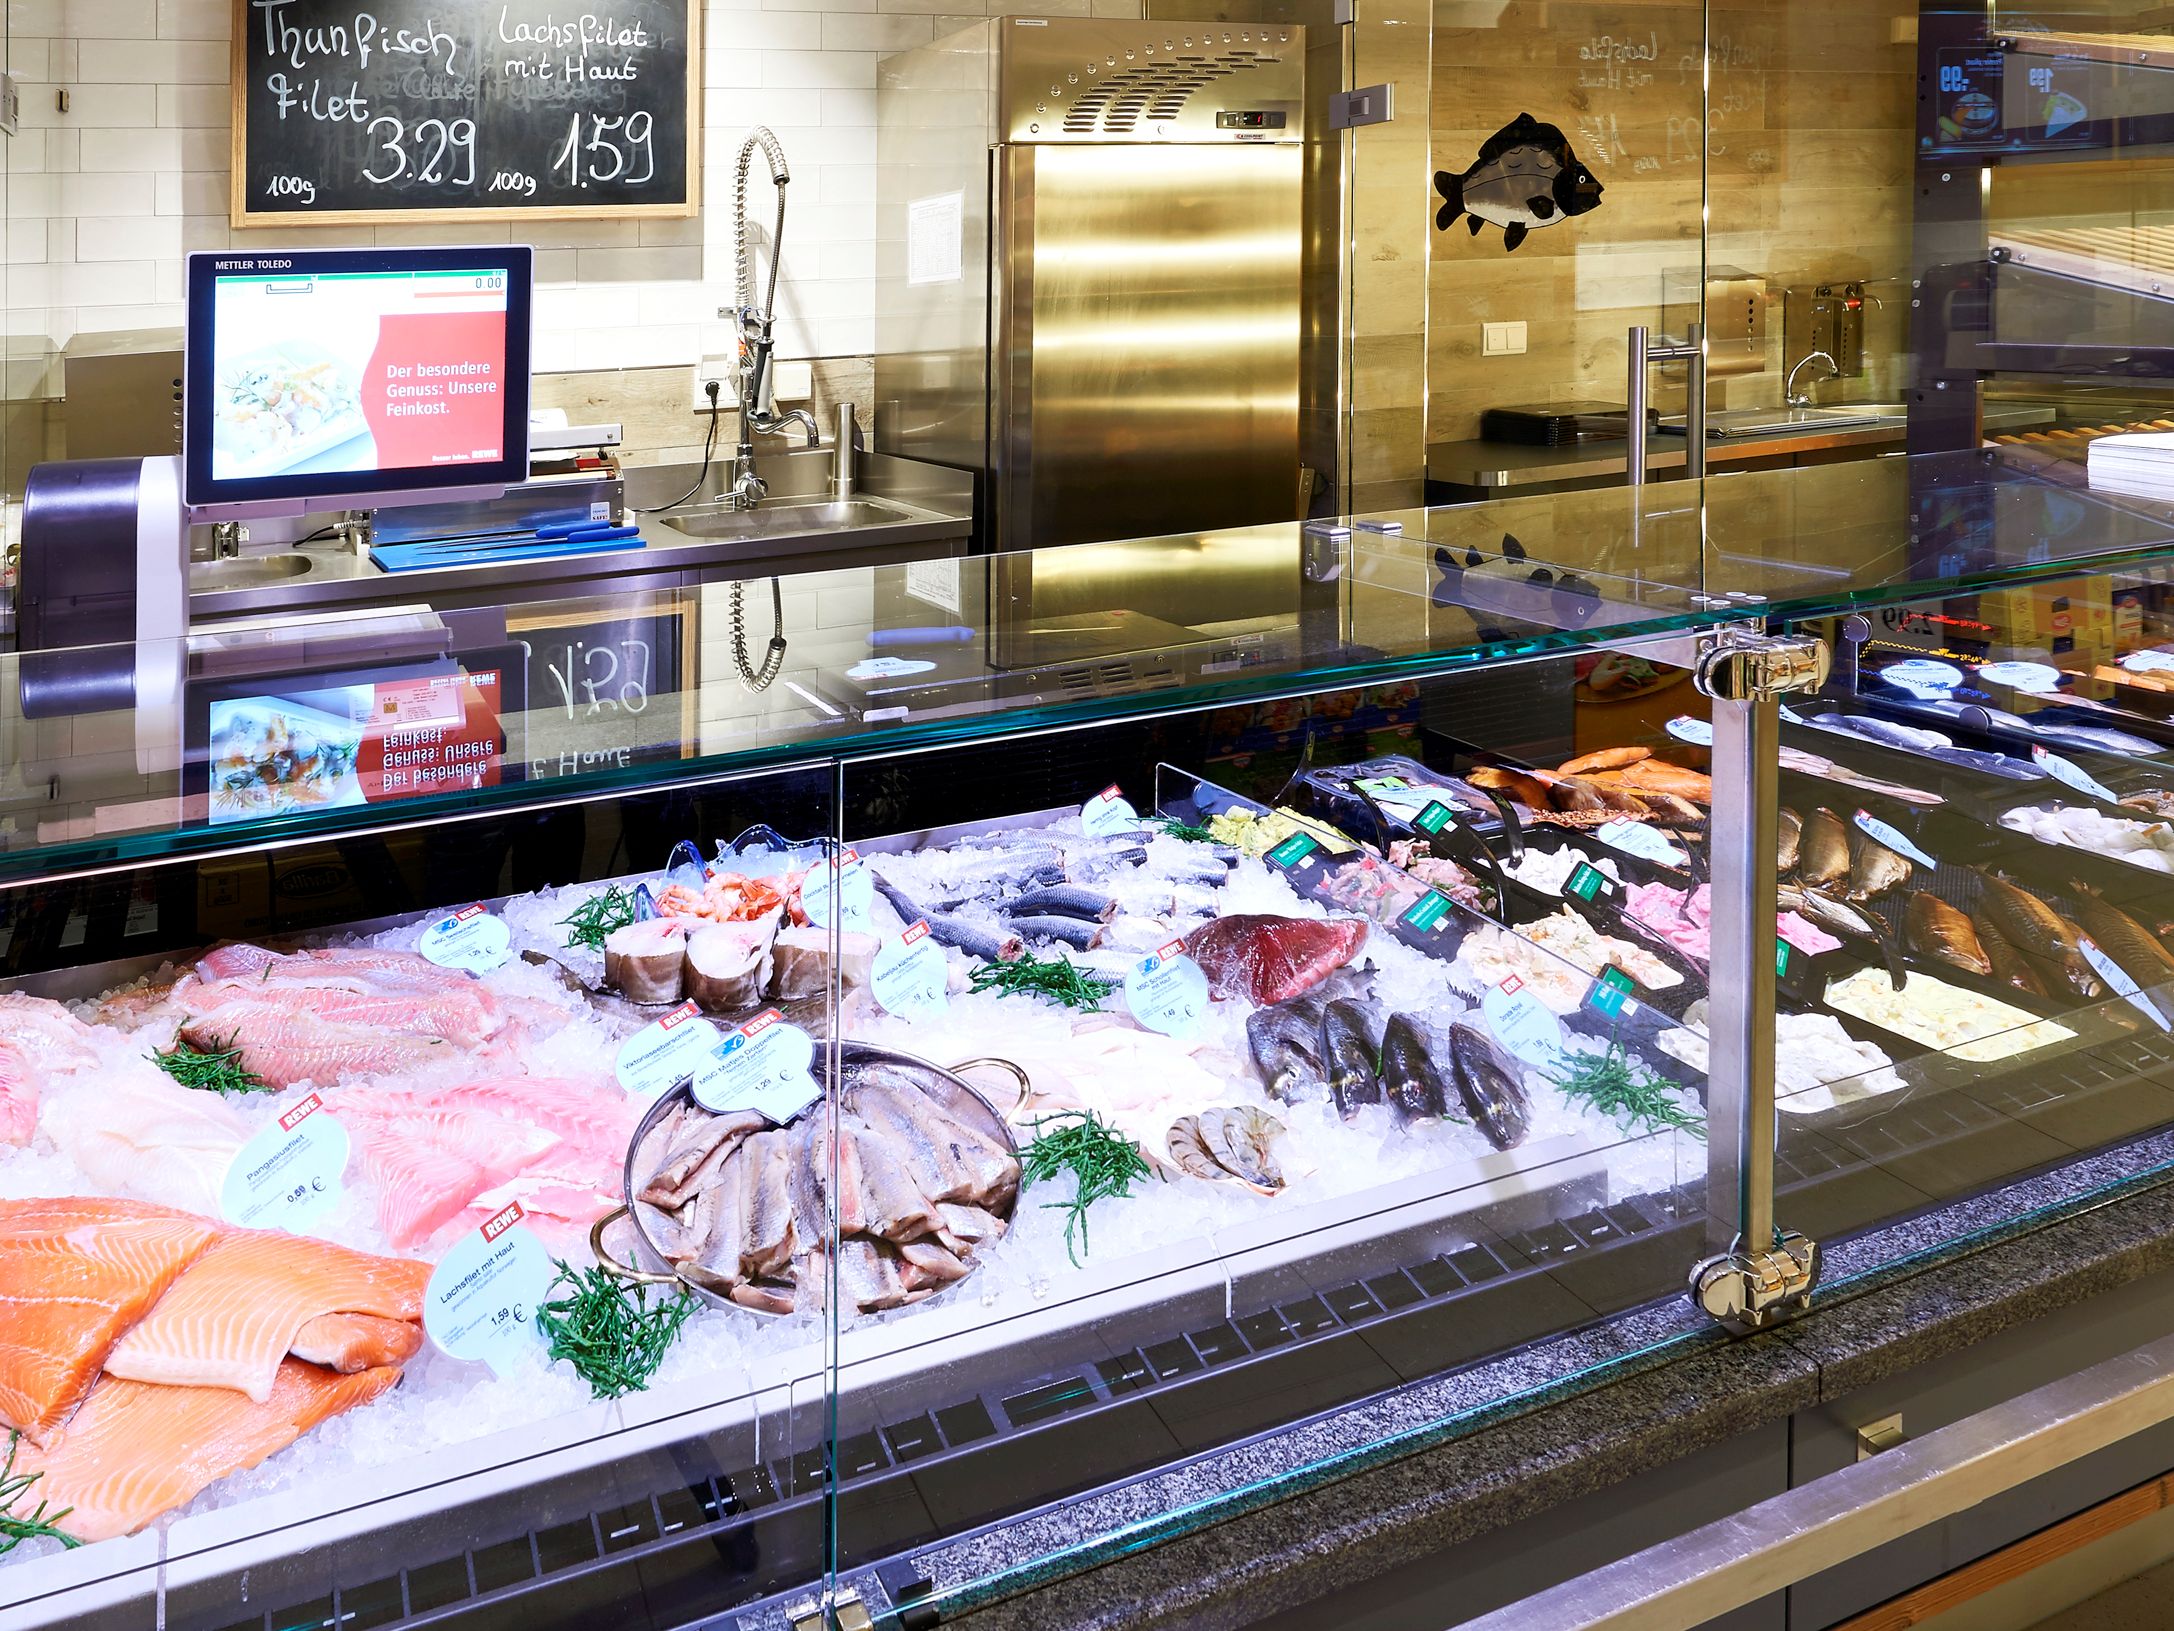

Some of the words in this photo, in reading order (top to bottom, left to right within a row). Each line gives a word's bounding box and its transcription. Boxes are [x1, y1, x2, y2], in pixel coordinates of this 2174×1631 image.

[499, 4, 648, 58] Lachsfilet
[505, 52, 553, 80] mit
[565, 55, 638, 82] Haut
[266, 72, 369, 123] Filet
[362, 116, 476, 186] 3.29
[553, 111, 654, 189] 1.59
[266, 175, 316, 205] 100g
[488, 171, 537, 196] 100g
[215, 260, 254, 270] METTLER
[257, 259, 292, 269] TOLEDO
[475, 277, 502, 289] 0.00
[387, 364, 412, 379] Der
[416, 361, 491, 377] besondere
[387, 382, 444, 398] Genuss:
[448, 381, 497, 395] Unsere
[386, 401, 450, 417] Feinkost.
[457, 905, 483, 920] REWE
[904, 923, 927, 944] REWE
[1160, 941, 1183, 959] REWE
[1501, 975, 1521, 994] REWE
[664, 1006, 693, 1030] REWE
[750, 1012, 777, 1035] REWE
[698, 1070, 719, 1086] MSC
[717, 1053, 745, 1073] Matjes
[743, 1028, 784, 1056] Doppelfilet
[754, 1077, 772, 1093] 1,29
[283, 1097, 319, 1127] REWE
[246, 1133, 306, 1182] Pangasiusfilet
[485, 1205, 520, 1239] REWE
[440, 1268, 482, 1304] Lachsfilet
[481, 1257, 496, 1273] mit
[494, 1241, 516, 1261] Haut
[490, 1307, 510, 1327] 1,59
[512, 1303, 528, 1324] €
